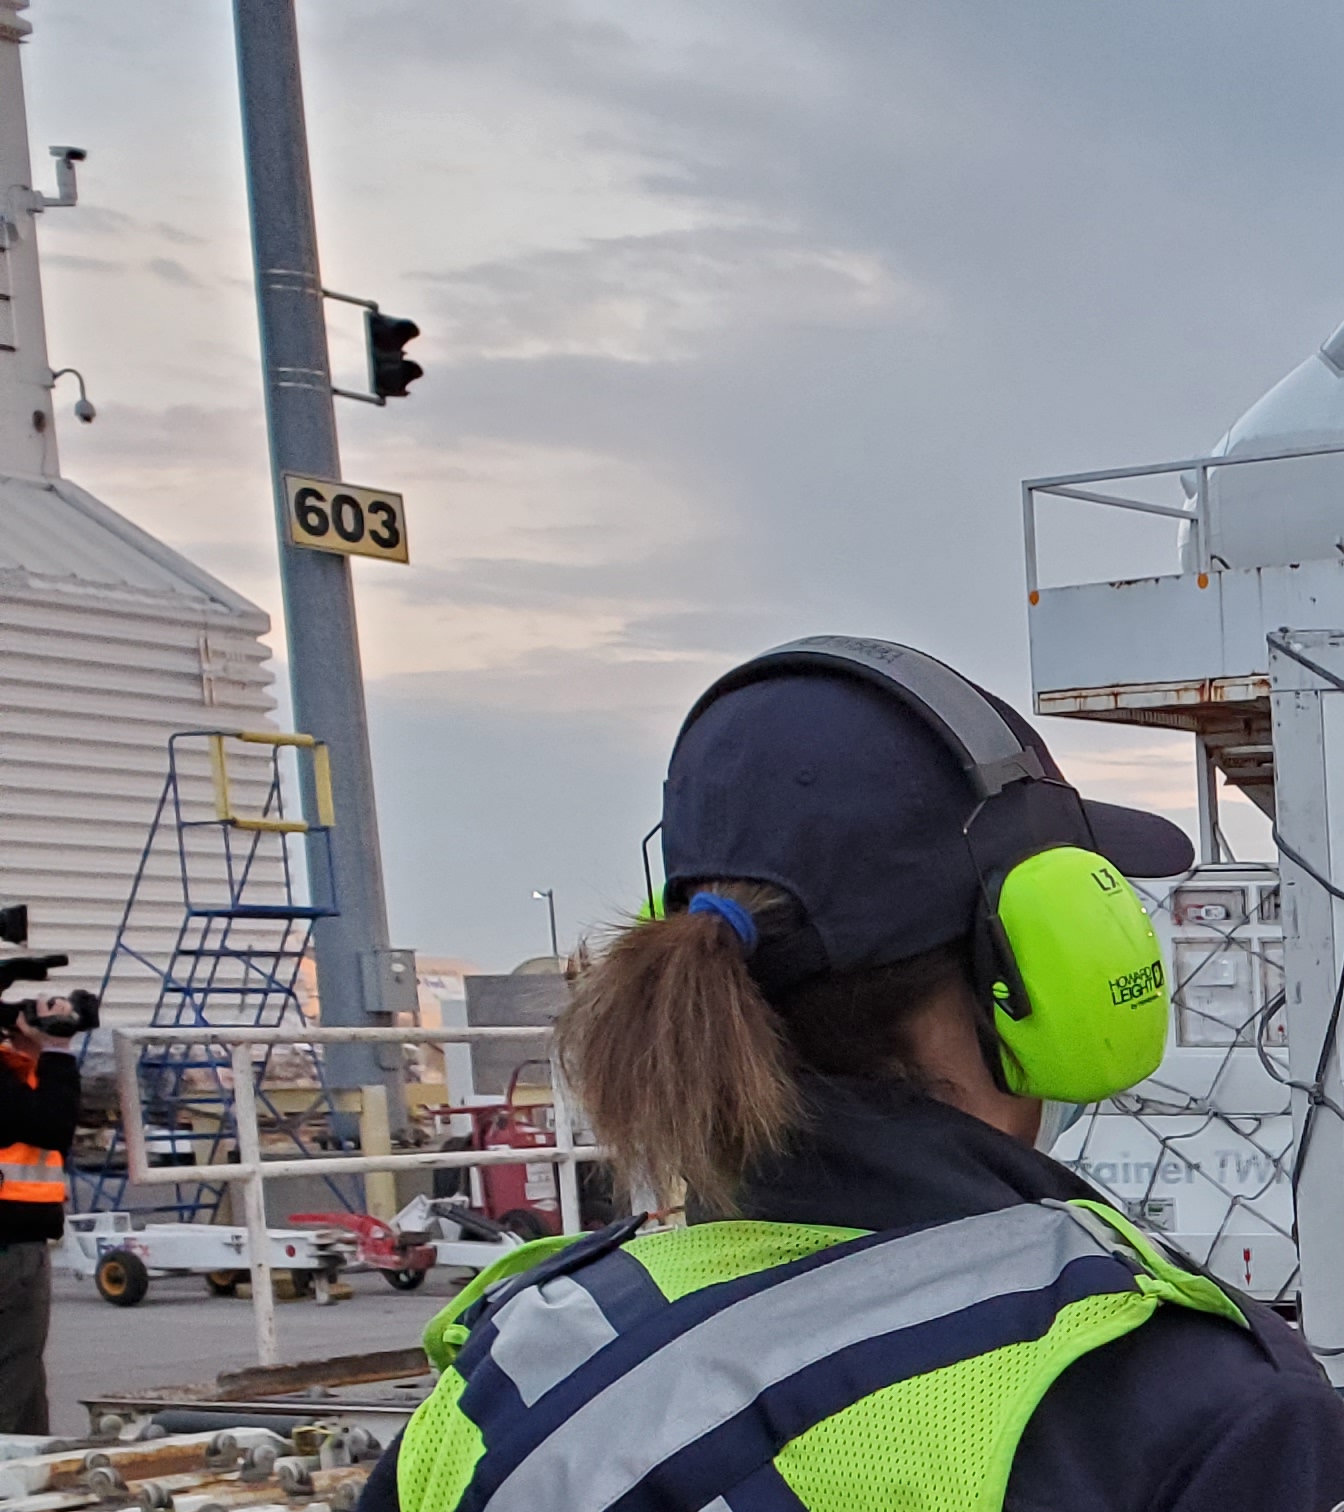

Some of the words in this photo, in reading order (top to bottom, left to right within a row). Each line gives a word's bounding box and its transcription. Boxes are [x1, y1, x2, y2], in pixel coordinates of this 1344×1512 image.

[294, 487, 400, 549] 603
[1091, 868, 1118, 891] L3
[1109, 966, 1152, 991] HOWARD
[1112, 976, 1153, 1006] LEIGHT
[1213, 1149, 1293, 1185] TWI
